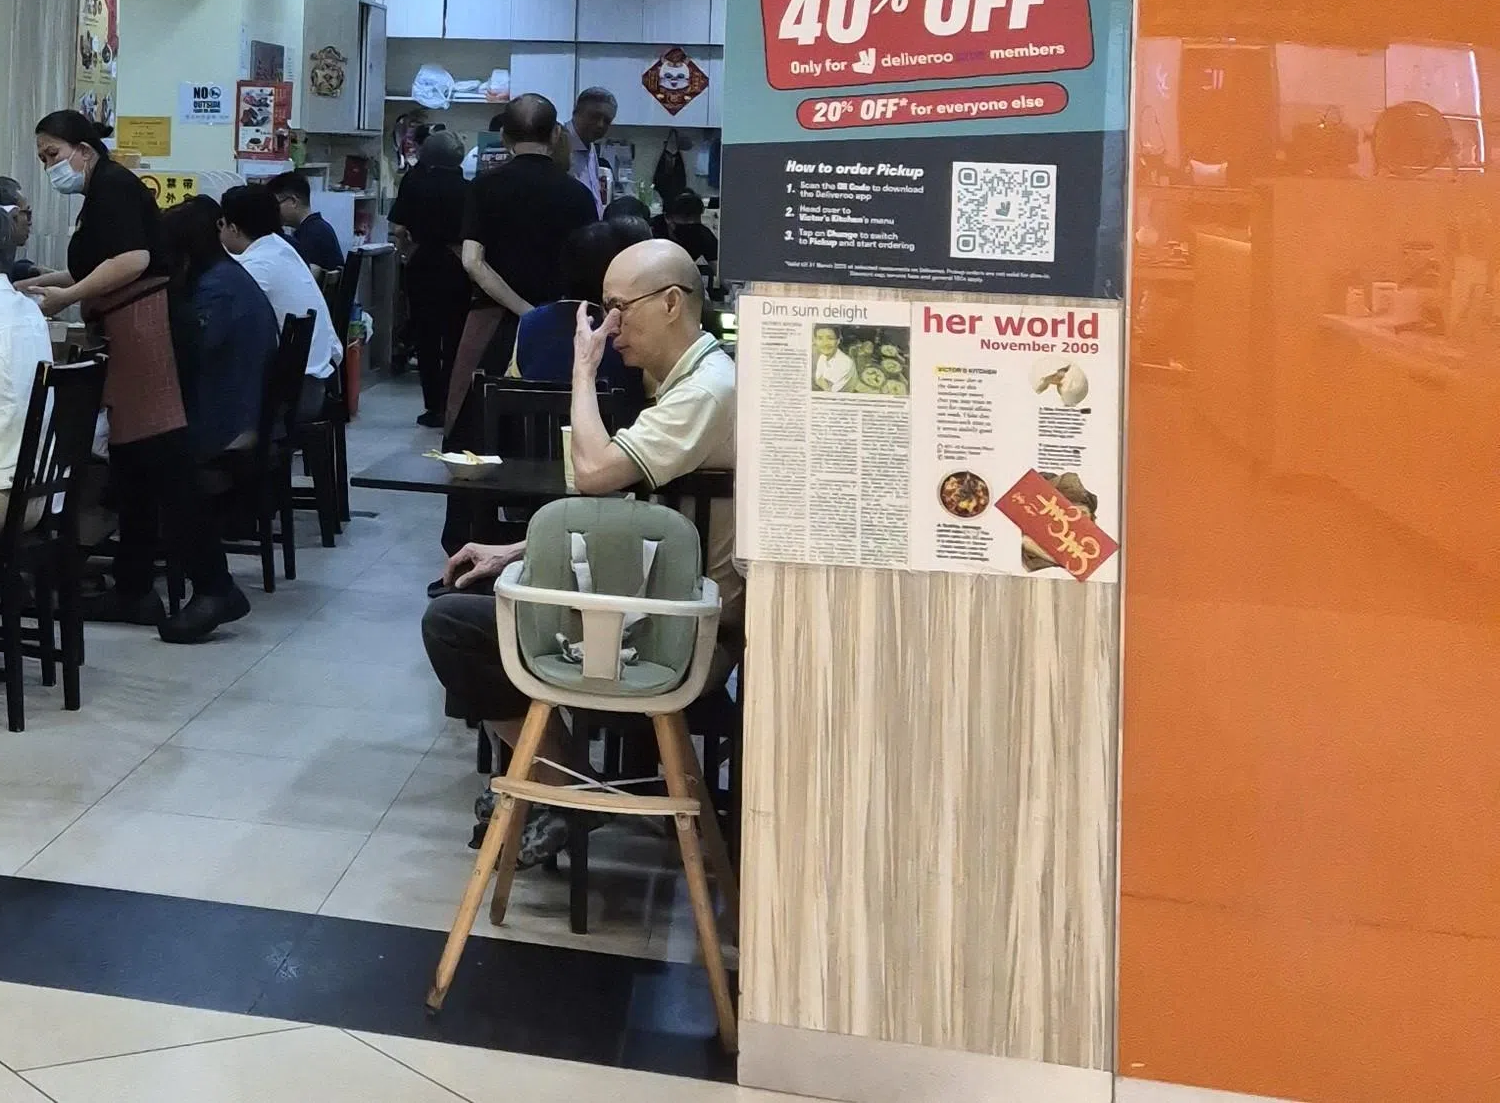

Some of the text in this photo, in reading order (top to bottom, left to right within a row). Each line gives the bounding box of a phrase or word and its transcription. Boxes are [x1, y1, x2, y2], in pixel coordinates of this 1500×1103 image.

[790, 60, 822, 76] Only
[825, 59, 848, 72] for
[881, 52, 954, 68] deliveroo
[989, 43, 1066, 60] members
[192, 86, 209, 99] NO
[812, 101, 854, 123] 20%
[910, 102, 932, 115] for
[936, 98, 1008, 116] everyone
[1011, 95, 1045, 109] else
[785, 159, 924, 181] How to order Pickup
[786, 183, 796, 194] 1.
[800, 181, 821, 190] Scan
[821, 182, 836, 191] the
[872, 184, 881, 193] to
[882, 185, 924, 195] download
[800, 190, 873, 202] the Deliveroo app
[785, 205, 852, 218] 2. Head over to
[870, 217, 895, 226] menu
[784, 229, 794, 241] 3.
[799, 228, 814, 238] Tap
[826, 229, 859, 240] Change
[859, 231, 869, 239] to
[870, 231, 899, 241] switch
[798, 237, 916, 253] to Pickup and start ordering
[761, 301, 869, 321] Dim sum delight
[923, 306, 1099, 340] her world
[980, 338, 1100, 355] November 2009
